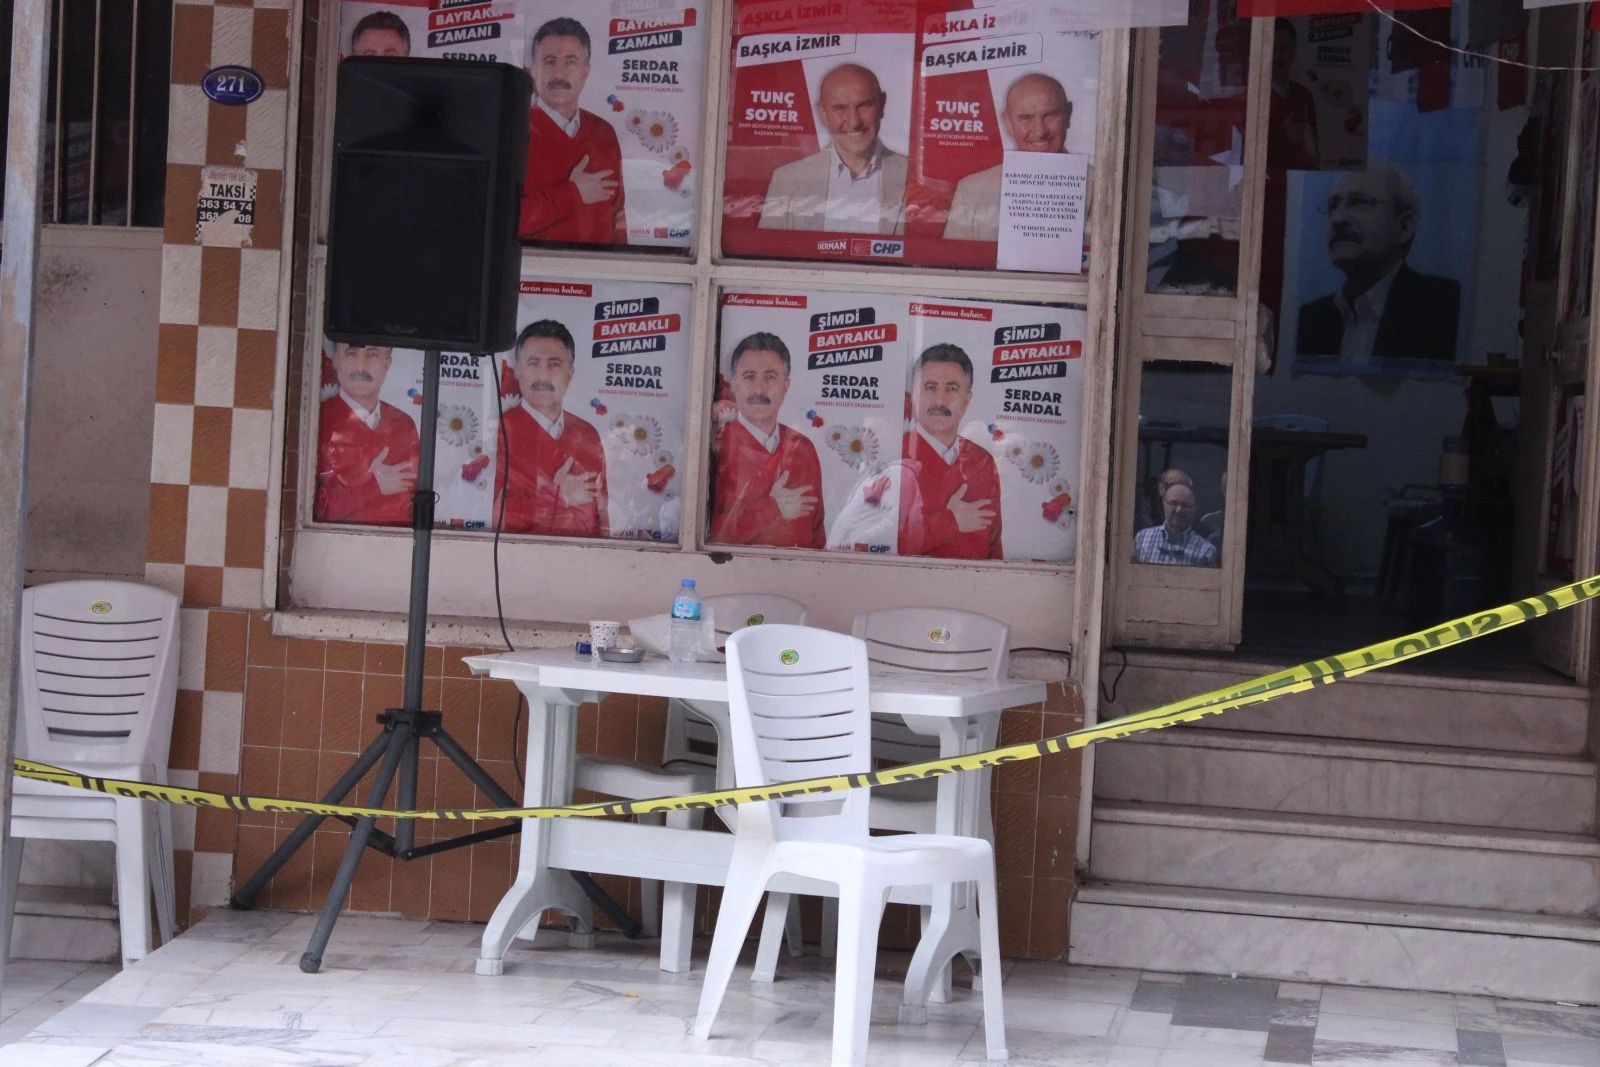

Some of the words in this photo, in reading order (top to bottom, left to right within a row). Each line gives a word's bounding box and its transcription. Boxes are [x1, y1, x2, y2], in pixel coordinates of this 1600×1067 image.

[743, 9, 793, 26] AŞKLA
[435, 25, 492, 44] ZAMANI
[928, 18, 979, 37] AŞKLA
[615, 32, 674, 50] ZAMANI
[740, 40, 792, 58] BAŞKA
[795, 33, 841, 51] İZMİR
[925, 50, 978, 68] BAŞKA
[981, 42, 1027, 60] İZMİR
[622, 59, 679, 71] SERDAR
[216, 74, 245, 93] 271
[621, 71, 679, 84] SANDAL
[750, 90, 795, 108] TUNÇ
[745, 107, 799, 123] SOYER
[935, 100, 980, 118] TUNÇ
[930, 118, 984, 133] SOYER
[210, 182, 246, 199] TAKSİ
[200, 200, 219, 209] 363
[223, 201, 236, 210] 54
[239, 202, 253, 211] 74
[669, 229, 690, 238] CHP
[817, 240, 847, 250] DERMAN
[872, 242, 901, 254] CHP
[602, 299, 644, 319] ŞİMDİ
[601, 319, 669, 336] BAYRAKLI
[818, 310, 860, 331] ŞİMDİ
[816, 329, 886, 348] BAYRAKLI
[1002, 324, 1045, 344] ŞİMDİ
[600, 338, 657, 354] ZAMANI
[1000, 345, 1070, 361] BAYRAKLI
[439, 355, 480, 367] RDAR
[815, 348, 874, 366] ZAMANI
[439, 367, 480, 380] NDAL
[606, 362, 662, 377] SERDAR
[999, 364, 1058, 380] ZAMANI
[605, 376, 663, 390] SANDAL
[822, 374, 879, 388] SERDAR
[821, 387, 880, 401] SANDAL
[1004, 388, 1062, 403] SERDAR
[1003, 402, 1062, 417] SANDAL
[870, 545, 891, 553] CHP
